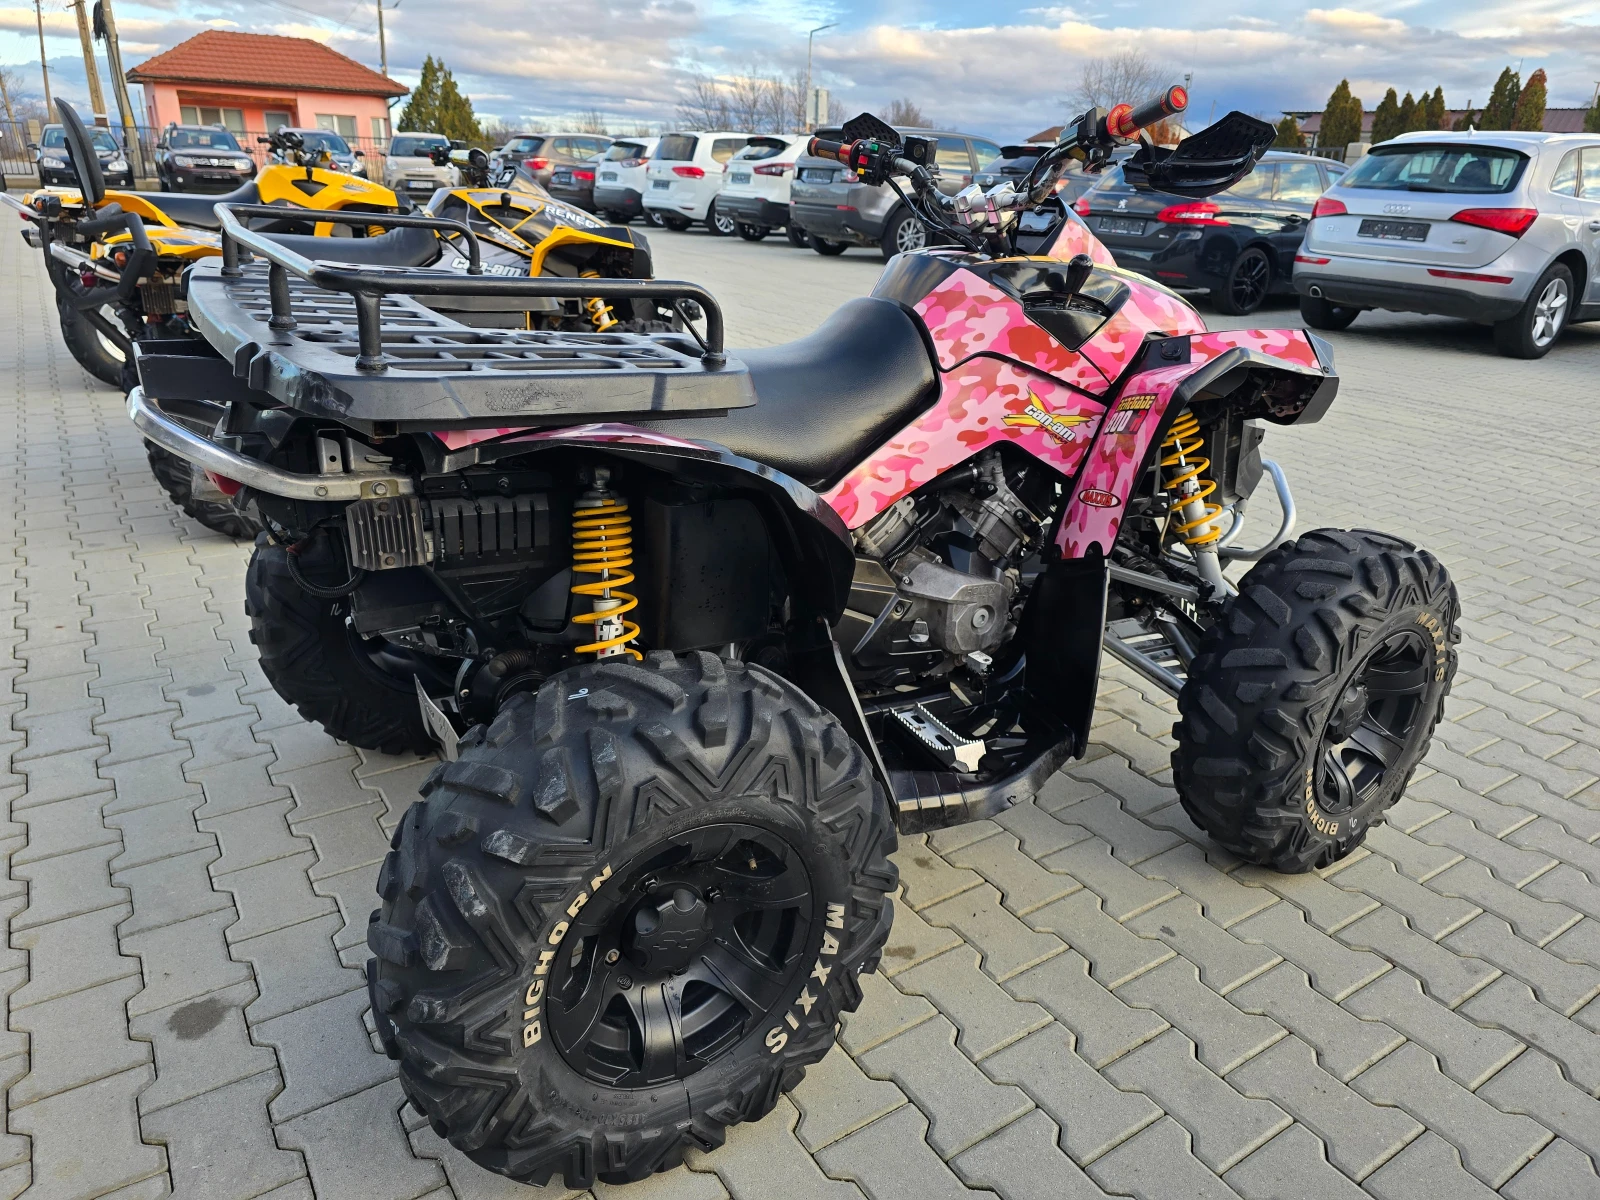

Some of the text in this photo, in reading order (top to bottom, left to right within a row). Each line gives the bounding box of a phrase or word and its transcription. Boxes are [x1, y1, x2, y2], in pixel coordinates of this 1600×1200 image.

[1024, 404, 1076, 442] can-am
[1104, 410, 1147, 434] 800 R
[1083, 490, 1113, 506] MAXXIS
[1414, 611, 1446, 682] MAXXIS
[1305, 768, 1340, 836] BIGHORN
[523, 863, 613, 1049] BIGHORN
[764, 902, 845, 1054] MAXXIS
